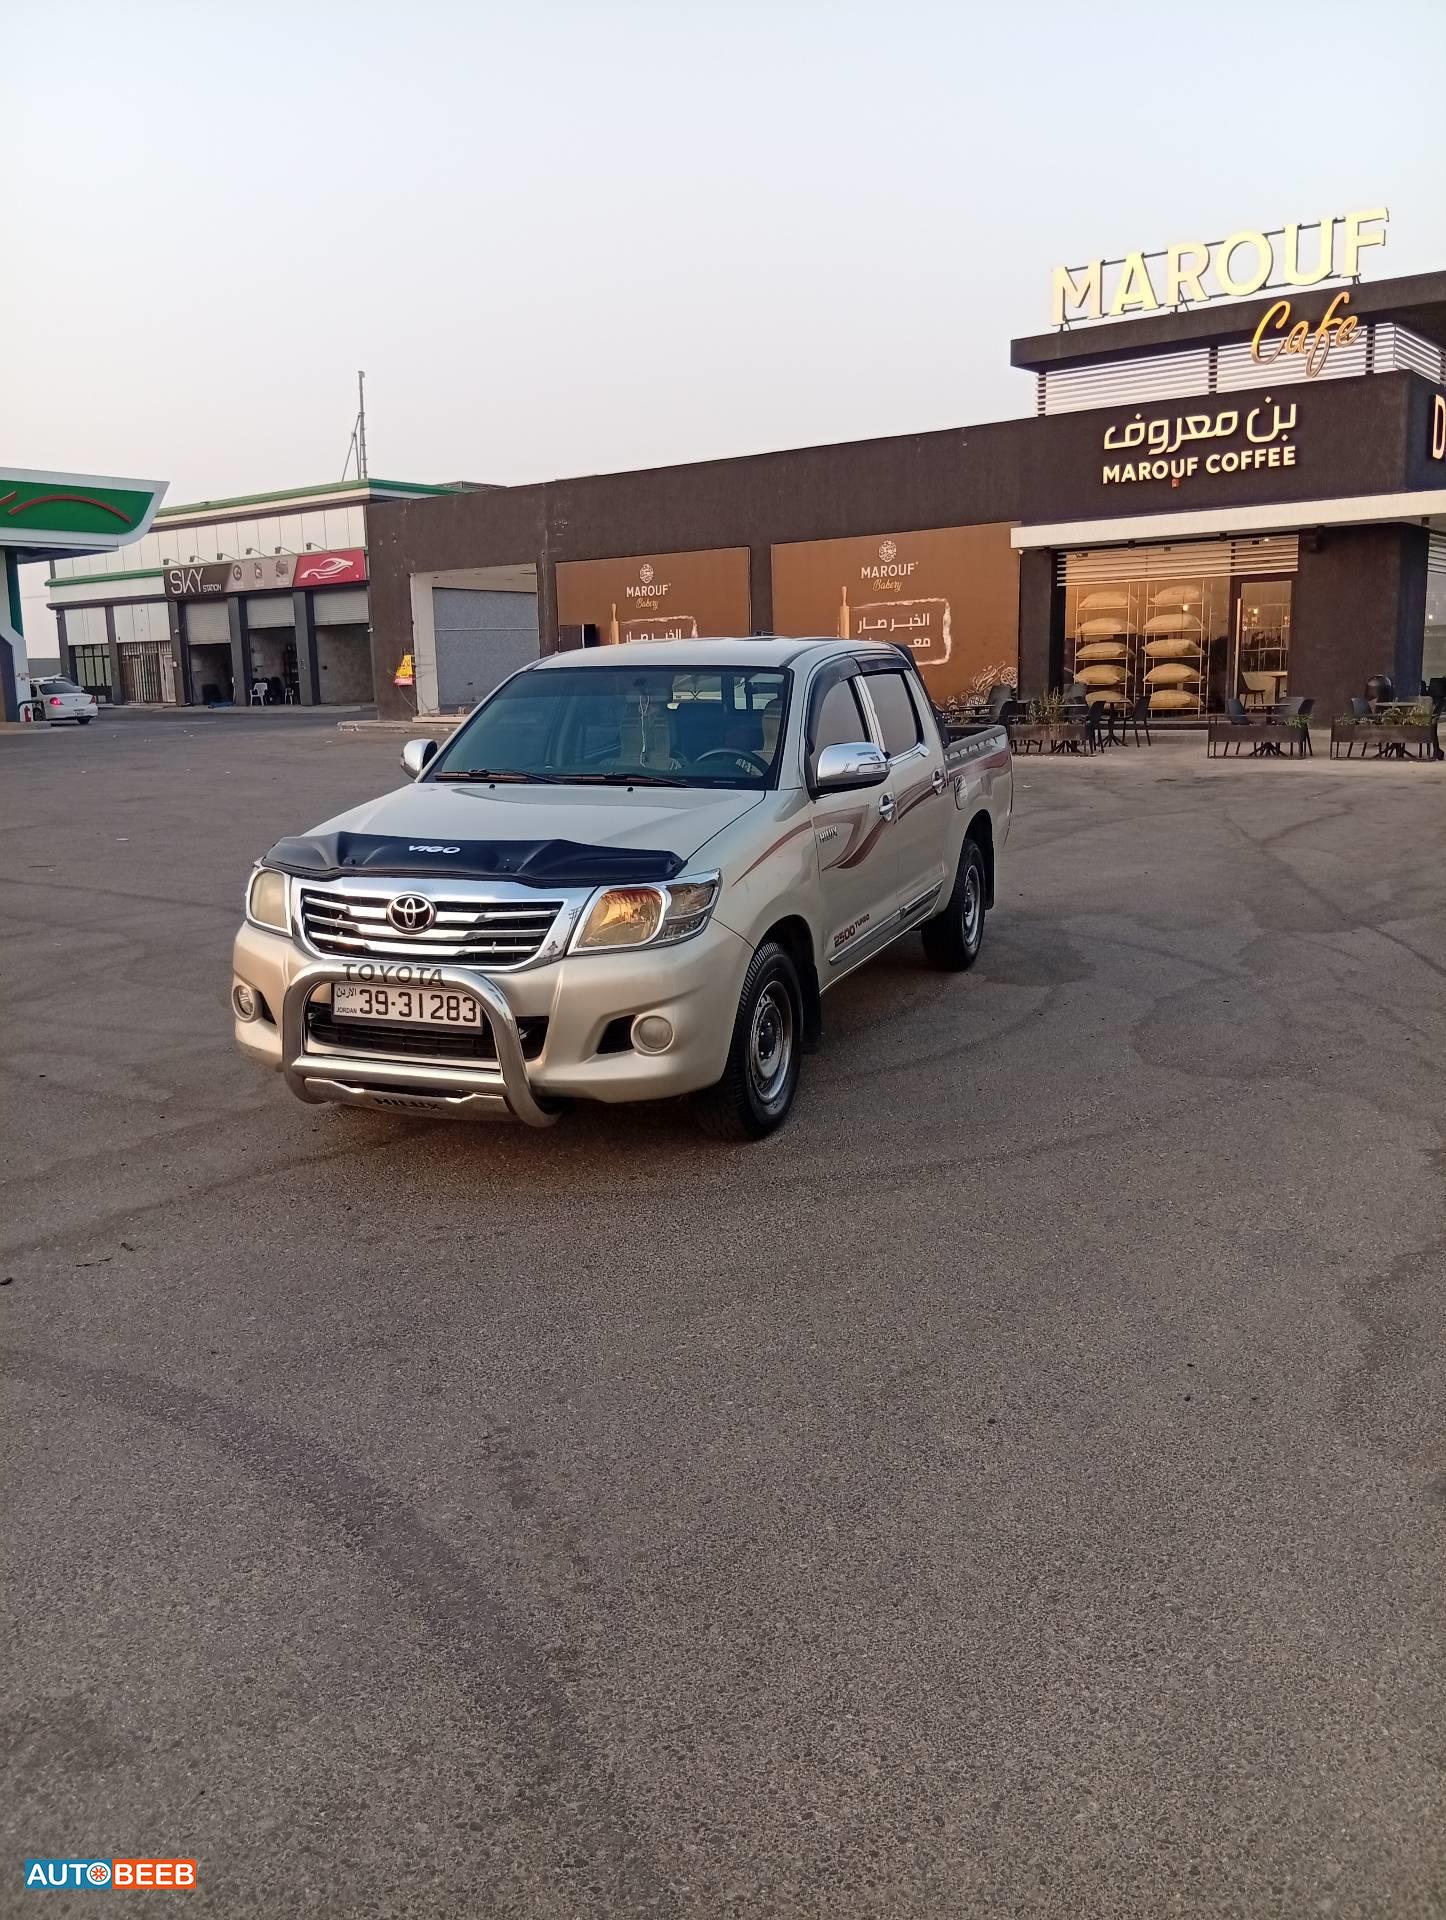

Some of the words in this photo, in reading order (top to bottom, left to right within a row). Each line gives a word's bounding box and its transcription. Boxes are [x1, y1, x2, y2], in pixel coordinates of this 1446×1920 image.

[1049, 207, 1389, 326] MAROUF
[1251, 291, 1364, 378] Cafe
[1246, 396, 1297, 443] بن
[1103, 410, 1239, 455] معروف
[1102, 456, 1199, 485] MAROUF
[1205, 446, 1297, 474] COFFEE
[169, 568, 204, 594] SKY
[202, 584, 222, 593] STATION
[861, 562, 916, 579] MAROUF
[626, 584, 669, 598] MAROUF
[873, 579, 902, 592] Bakery
[636, 598, 660, 610] Bakery
[857, 617, 887, 634] صار
[889, 613, 930, 631] الخبر
[409, 845, 461, 854] VIGO
[834, 925, 856, 948] 2500
[342, 963, 446, 987] TOYOTA
